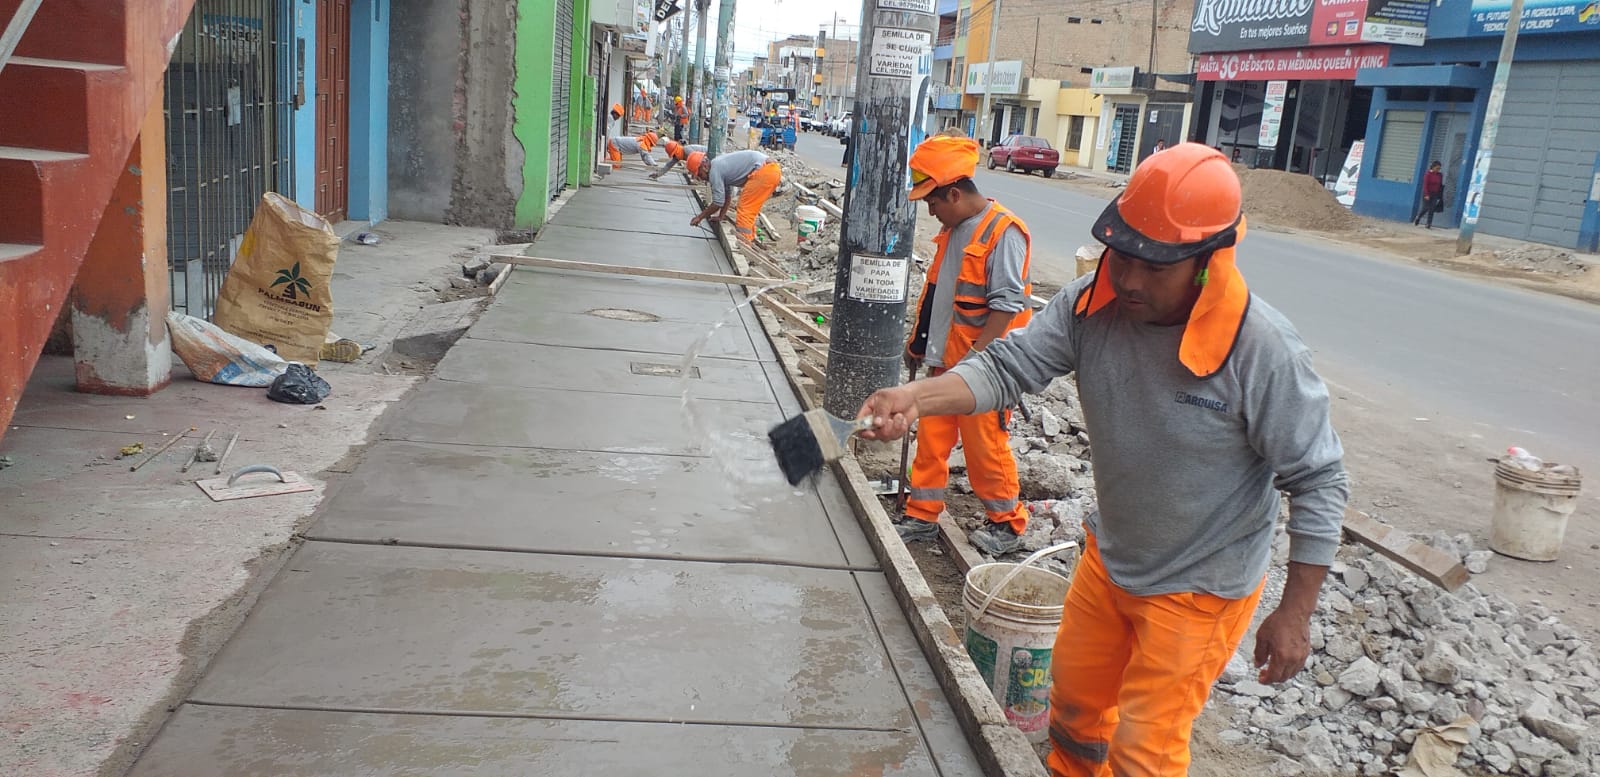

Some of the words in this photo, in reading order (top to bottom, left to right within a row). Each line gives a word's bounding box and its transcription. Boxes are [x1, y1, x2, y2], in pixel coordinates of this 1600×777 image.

[882, 30, 914, 40] SEMILLA
[915, 33, 925, 41] DE
[1240, 27, 1247, 39] En
[1248, 27, 1258, 38] tus
[1258, 26, 1282, 39] mejores
[1283, 23, 1308, 36] Sueños
[1200, 60, 1219, 72] HASTA
[1240, 60, 1250, 71] DE
[1277, 58, 1287, 71] EN
[1288, 57, 1322, 71] MEDIDAS
[1323, 56, 1351, 72] QUEEN
[1354, 57, 1360, 68] Y
[1360, 55, 1383, 69] KING
[860, 258, 891, 267] SEMILLA
[870, 269, 890, 277] PAPA
